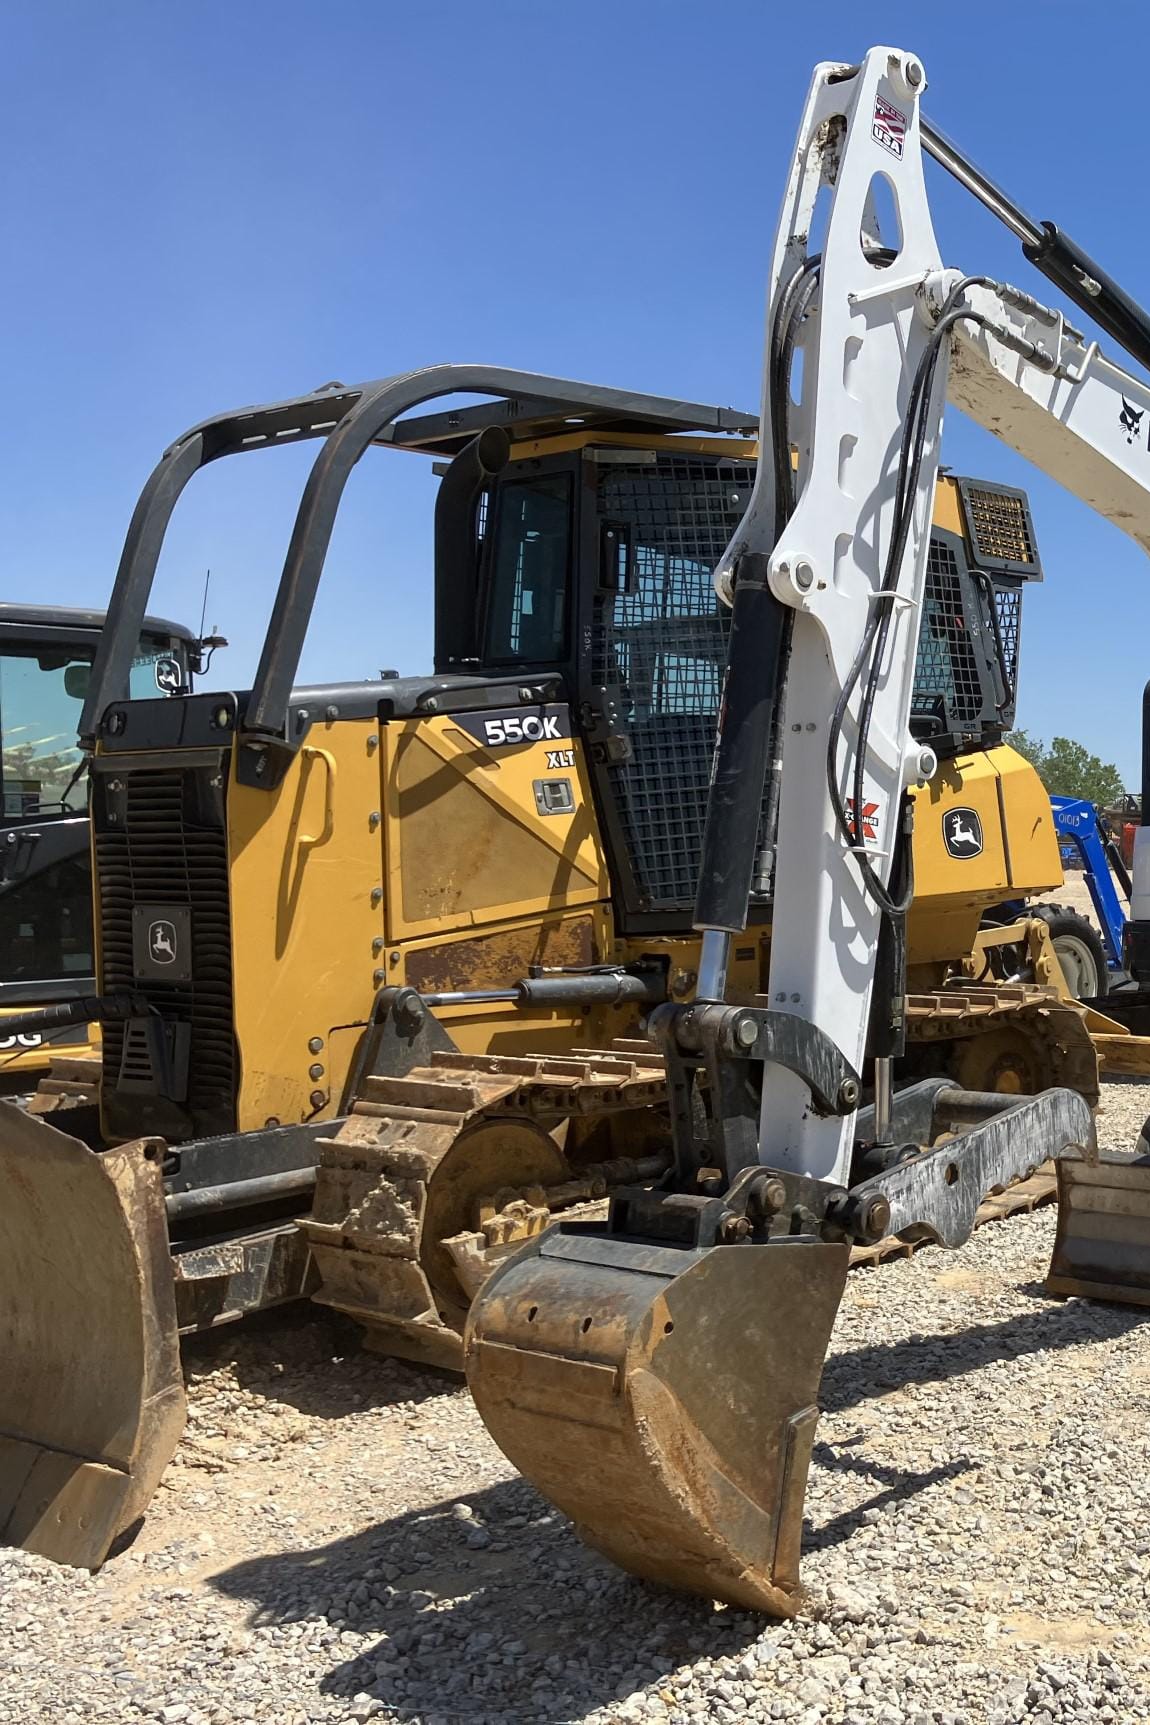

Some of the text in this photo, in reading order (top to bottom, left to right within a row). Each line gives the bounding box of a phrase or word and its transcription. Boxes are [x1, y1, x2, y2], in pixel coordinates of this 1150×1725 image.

[873, 124, 902, 155] USA
[484, 716, 562, 745] 550K
[545, 750, 576, 769] XLT
